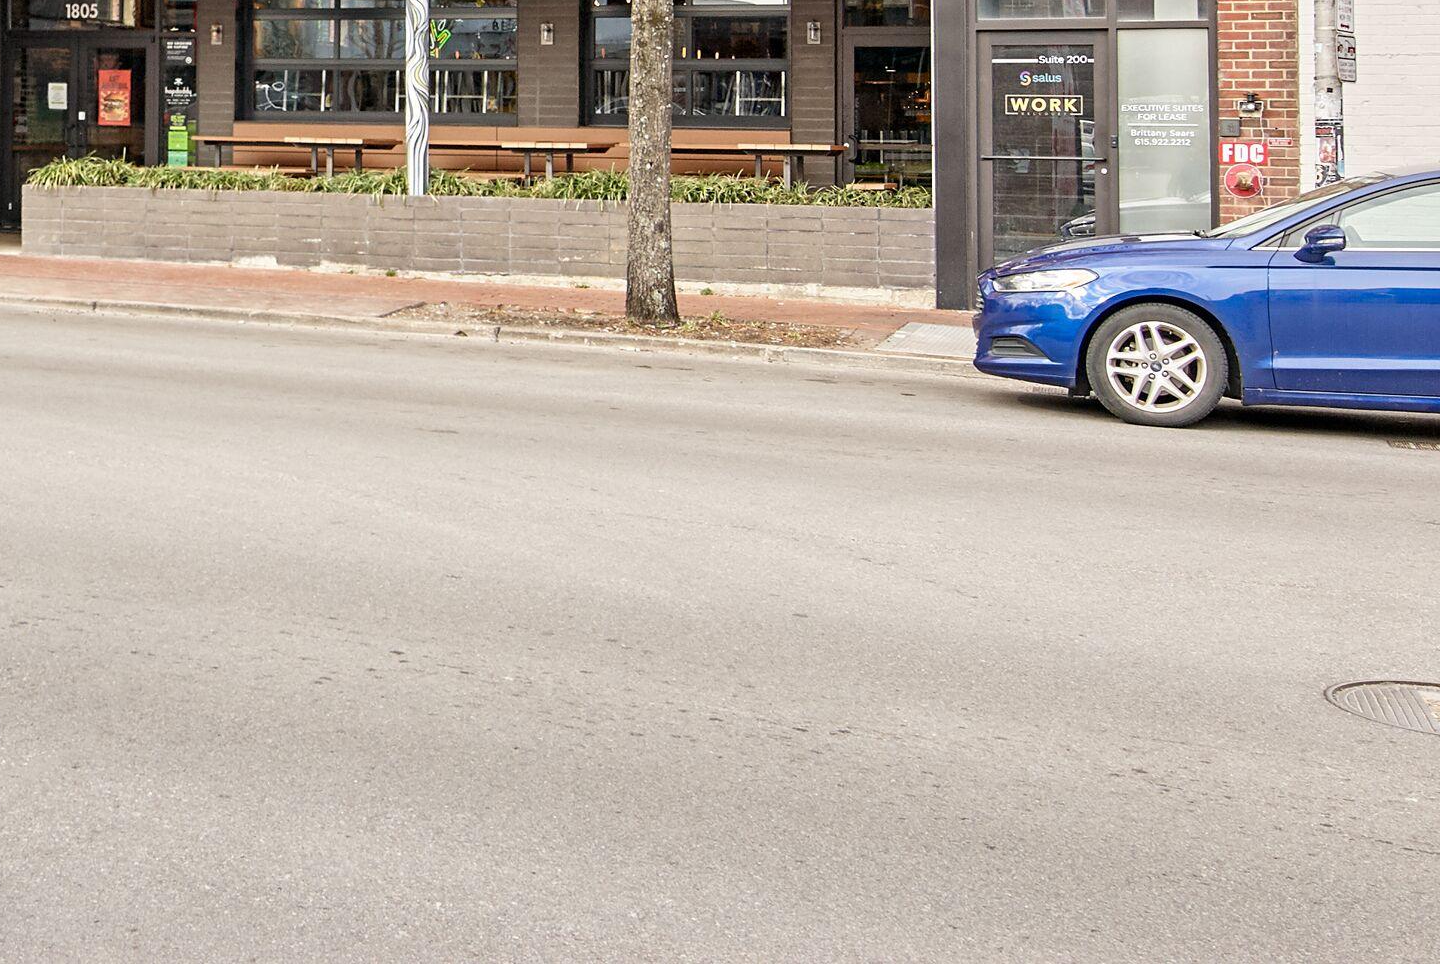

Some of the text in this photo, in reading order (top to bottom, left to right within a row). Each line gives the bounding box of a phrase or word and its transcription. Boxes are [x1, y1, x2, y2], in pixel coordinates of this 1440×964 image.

[65, 3, 98, 19] 1805
[1038, 55, 1088, 64] Suite 200
[1032, 73, 1062, 83] salus
[1010, 98, 1078, 112] WORK
[1121, 104, 1204, 112] EXECUTIVE SUITES
[1137, 113, 1188, 121] FOR LEASE
[1130, 129, 1195, 138] Brittany Sears
[1134, 138, 1191, 146] 615.922.2212
[1222, 143, 1264, 163] FDC
